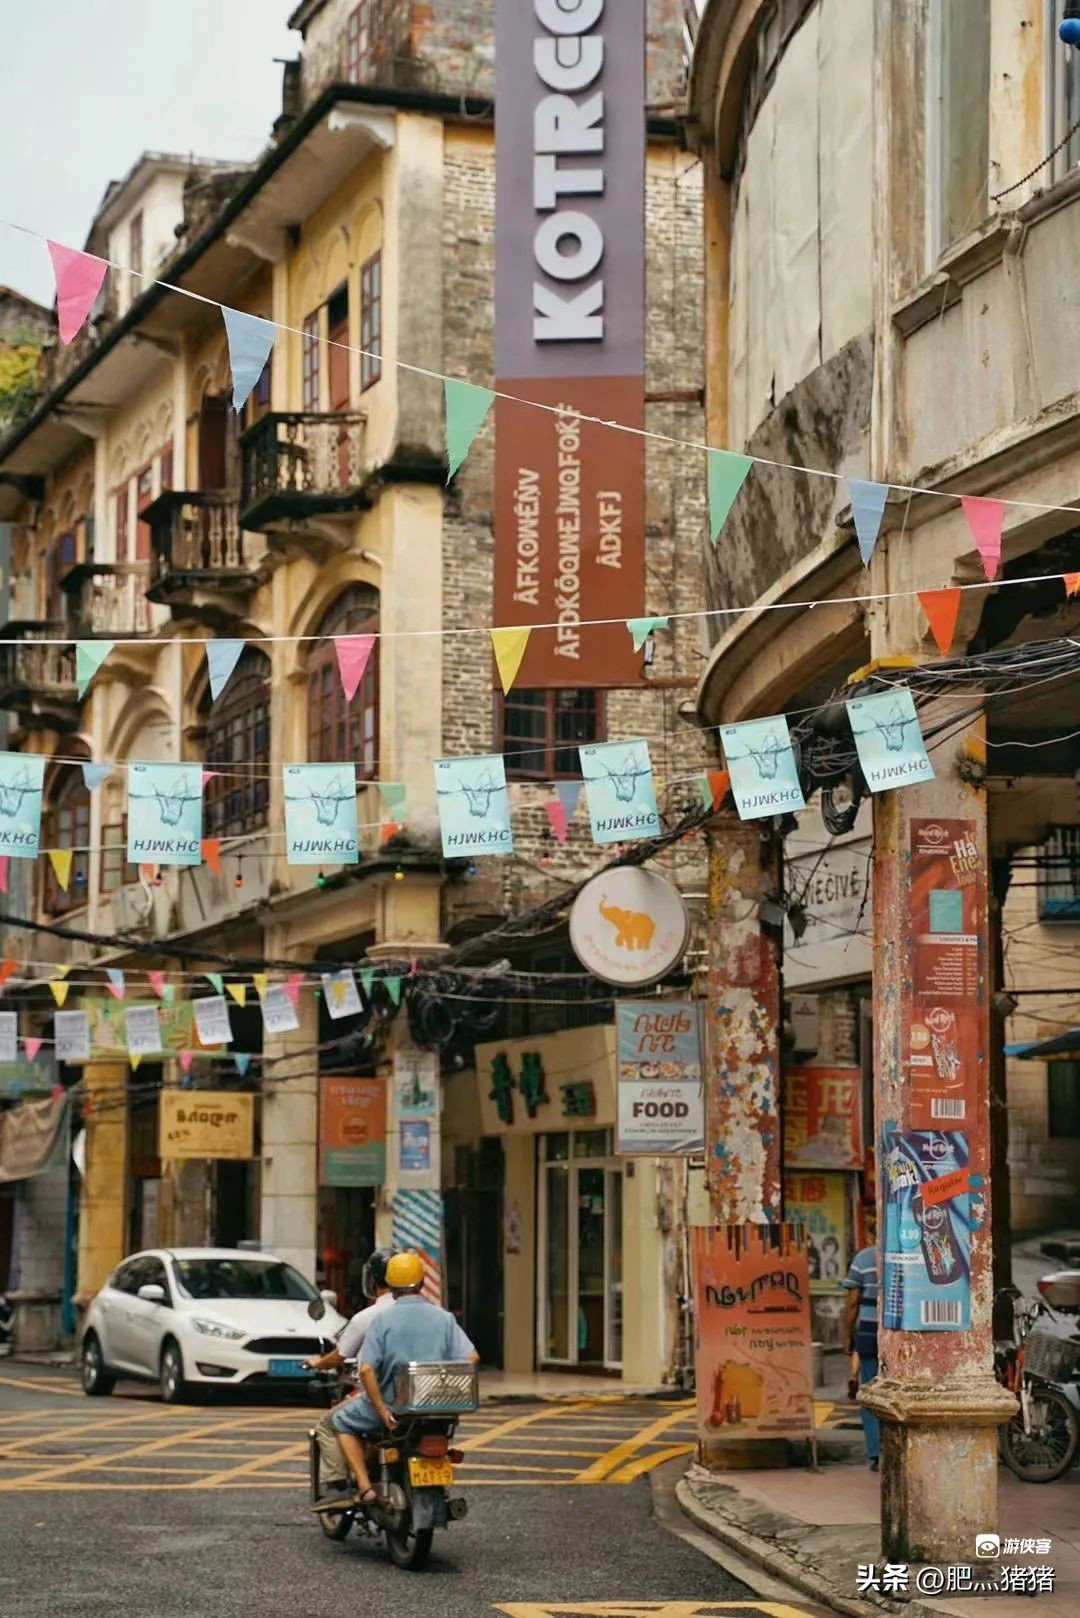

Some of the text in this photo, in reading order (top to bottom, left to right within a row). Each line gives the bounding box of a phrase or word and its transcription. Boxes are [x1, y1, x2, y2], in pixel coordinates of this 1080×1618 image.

[596, 812, 657, 832] HJWKHC
[134, 839, 200, 852] HJWKHC
[292, 839, 357, 852] HJWKHC
[448, 829, 510, 846] HJWKHC
[632, 1102, 689, 1119] FOOD
